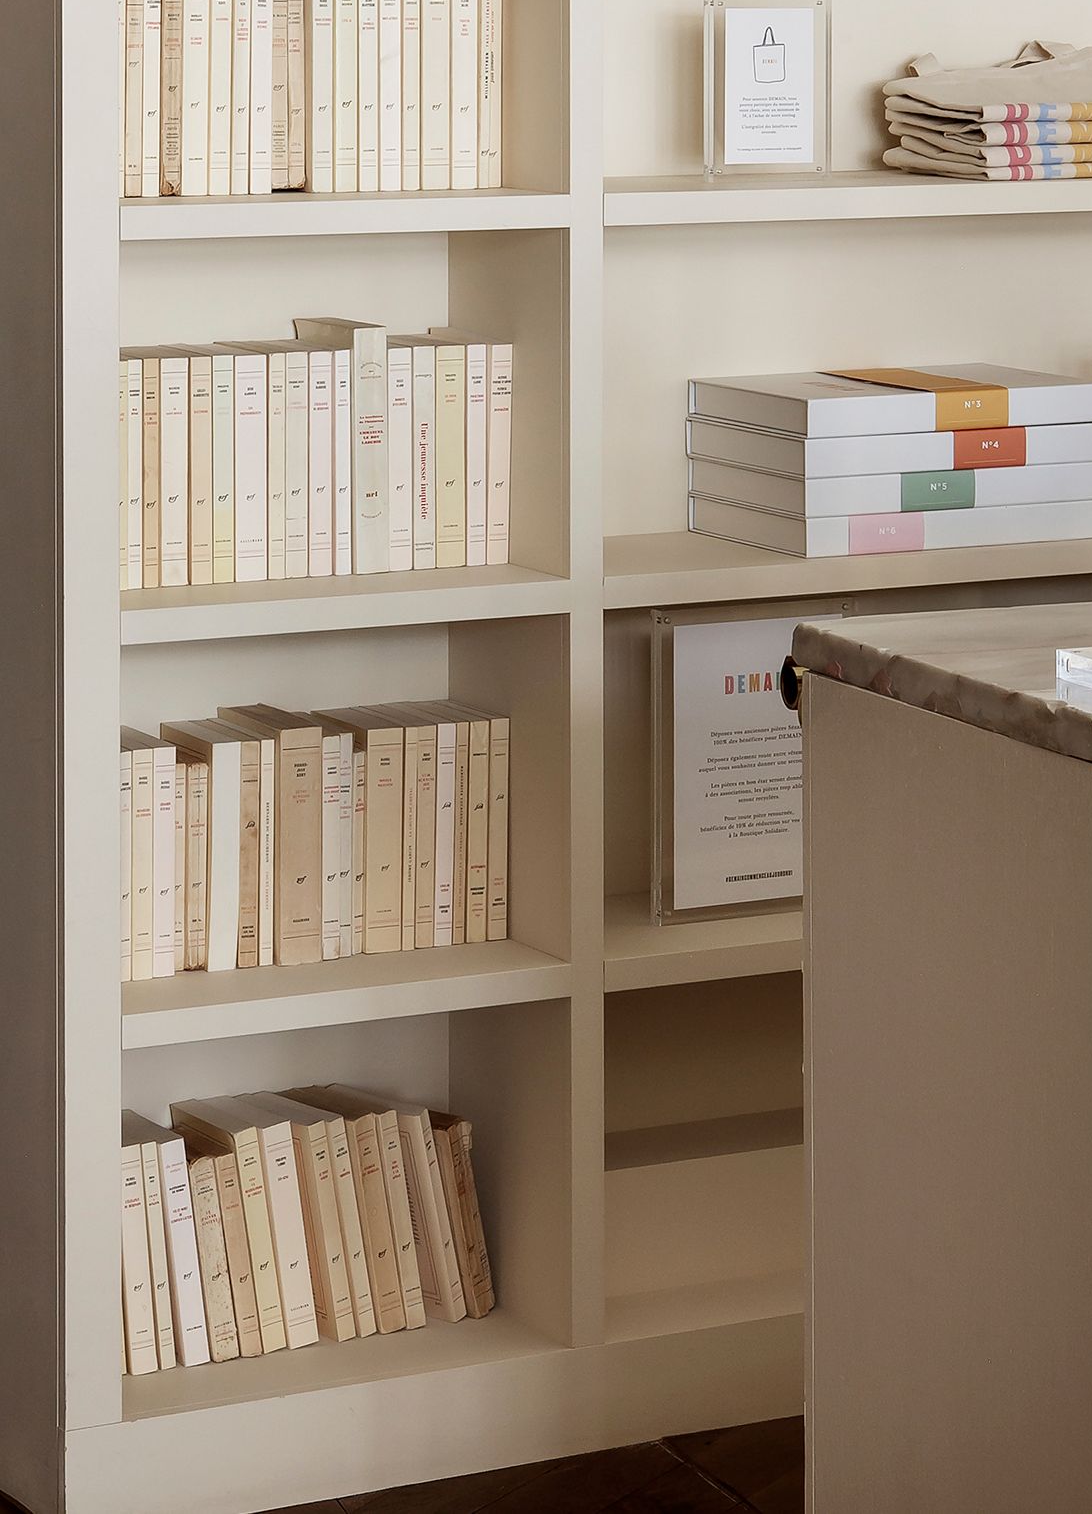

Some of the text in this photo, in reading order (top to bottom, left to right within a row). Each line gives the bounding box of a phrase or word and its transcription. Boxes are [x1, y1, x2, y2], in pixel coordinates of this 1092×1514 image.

[964, 400, 981, 409] N°3
[981, 440, 1000, 449] N°4
[418, 423, 429, 520] Une jeunesse inquiète
[930, 482, 947, 491] N°5
[879, 526, 896, 535] N°6
[725, 671, 780, 695] DEMAI
[730, 754, 756, 762] également
